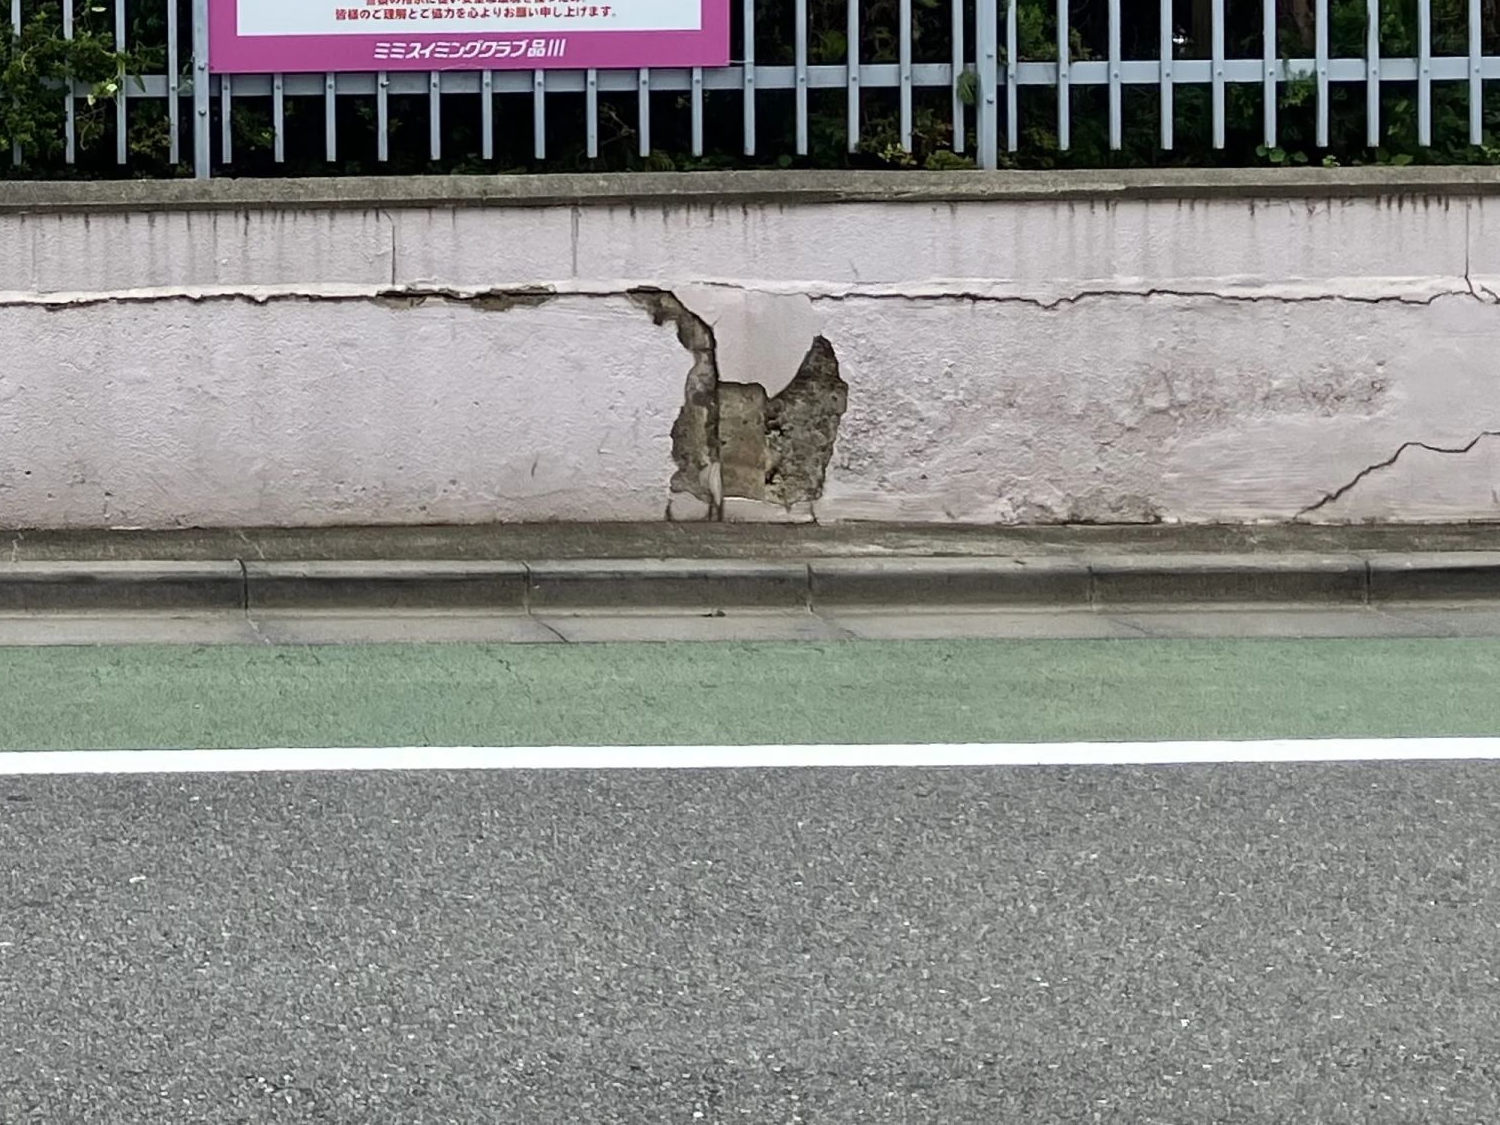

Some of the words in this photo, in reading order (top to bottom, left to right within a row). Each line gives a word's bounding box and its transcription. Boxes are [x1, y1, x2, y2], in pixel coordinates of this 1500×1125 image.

[373, 38, 567, 59] ミミスイミングクラブ品川
